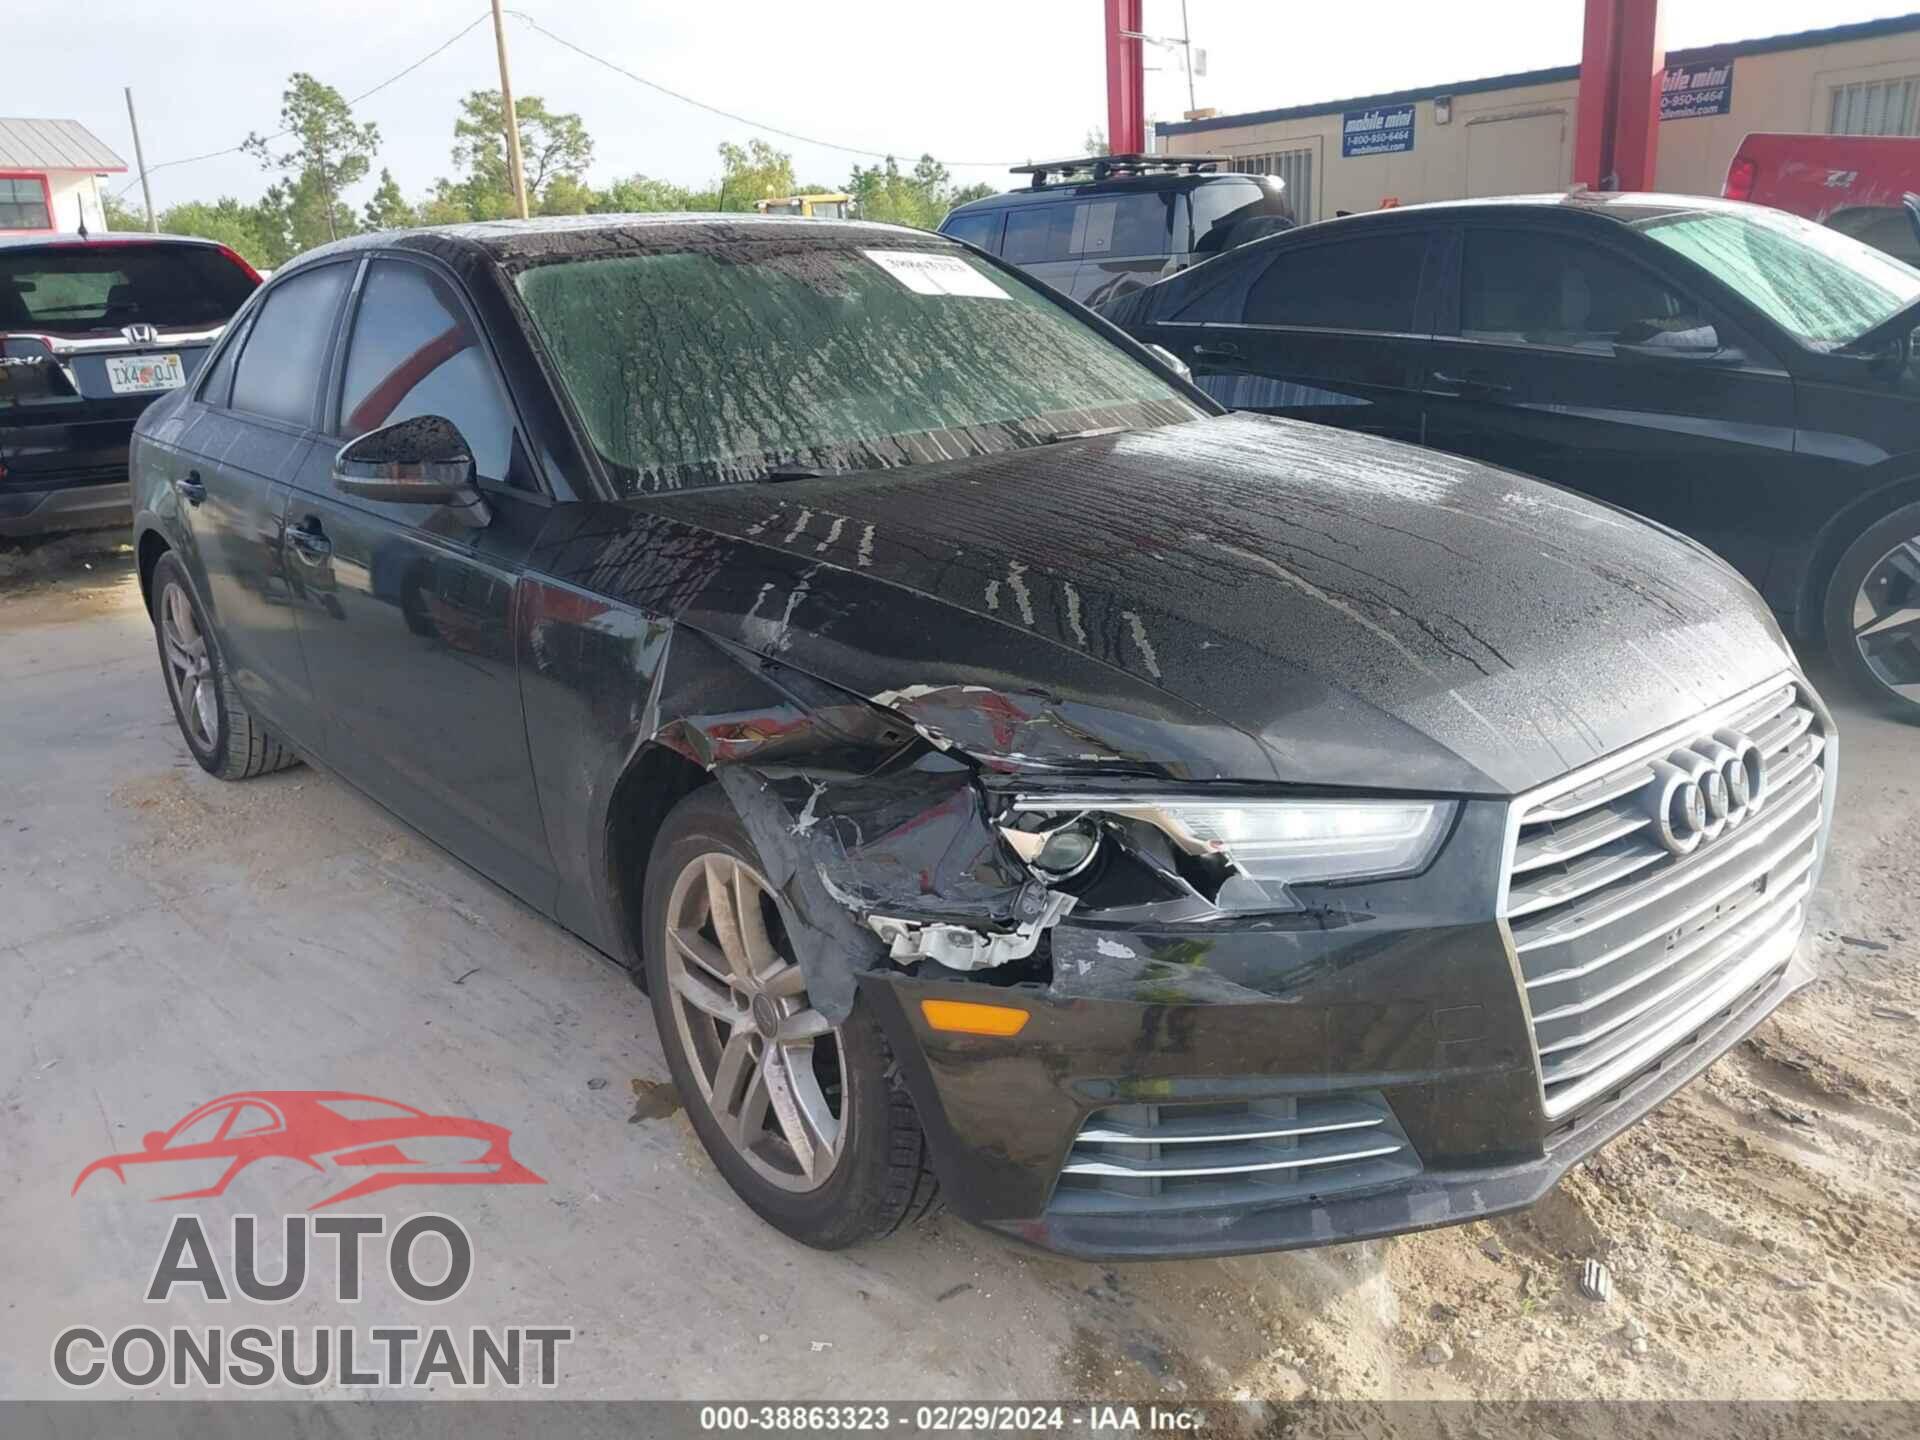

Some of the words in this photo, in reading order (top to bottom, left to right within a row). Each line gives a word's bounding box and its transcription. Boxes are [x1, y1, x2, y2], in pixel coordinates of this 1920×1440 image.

[1690, 65, 1730, 88] mini
[1345, 111, 1384, 133] mobile
[1385, 109, 1413, 128] mini
